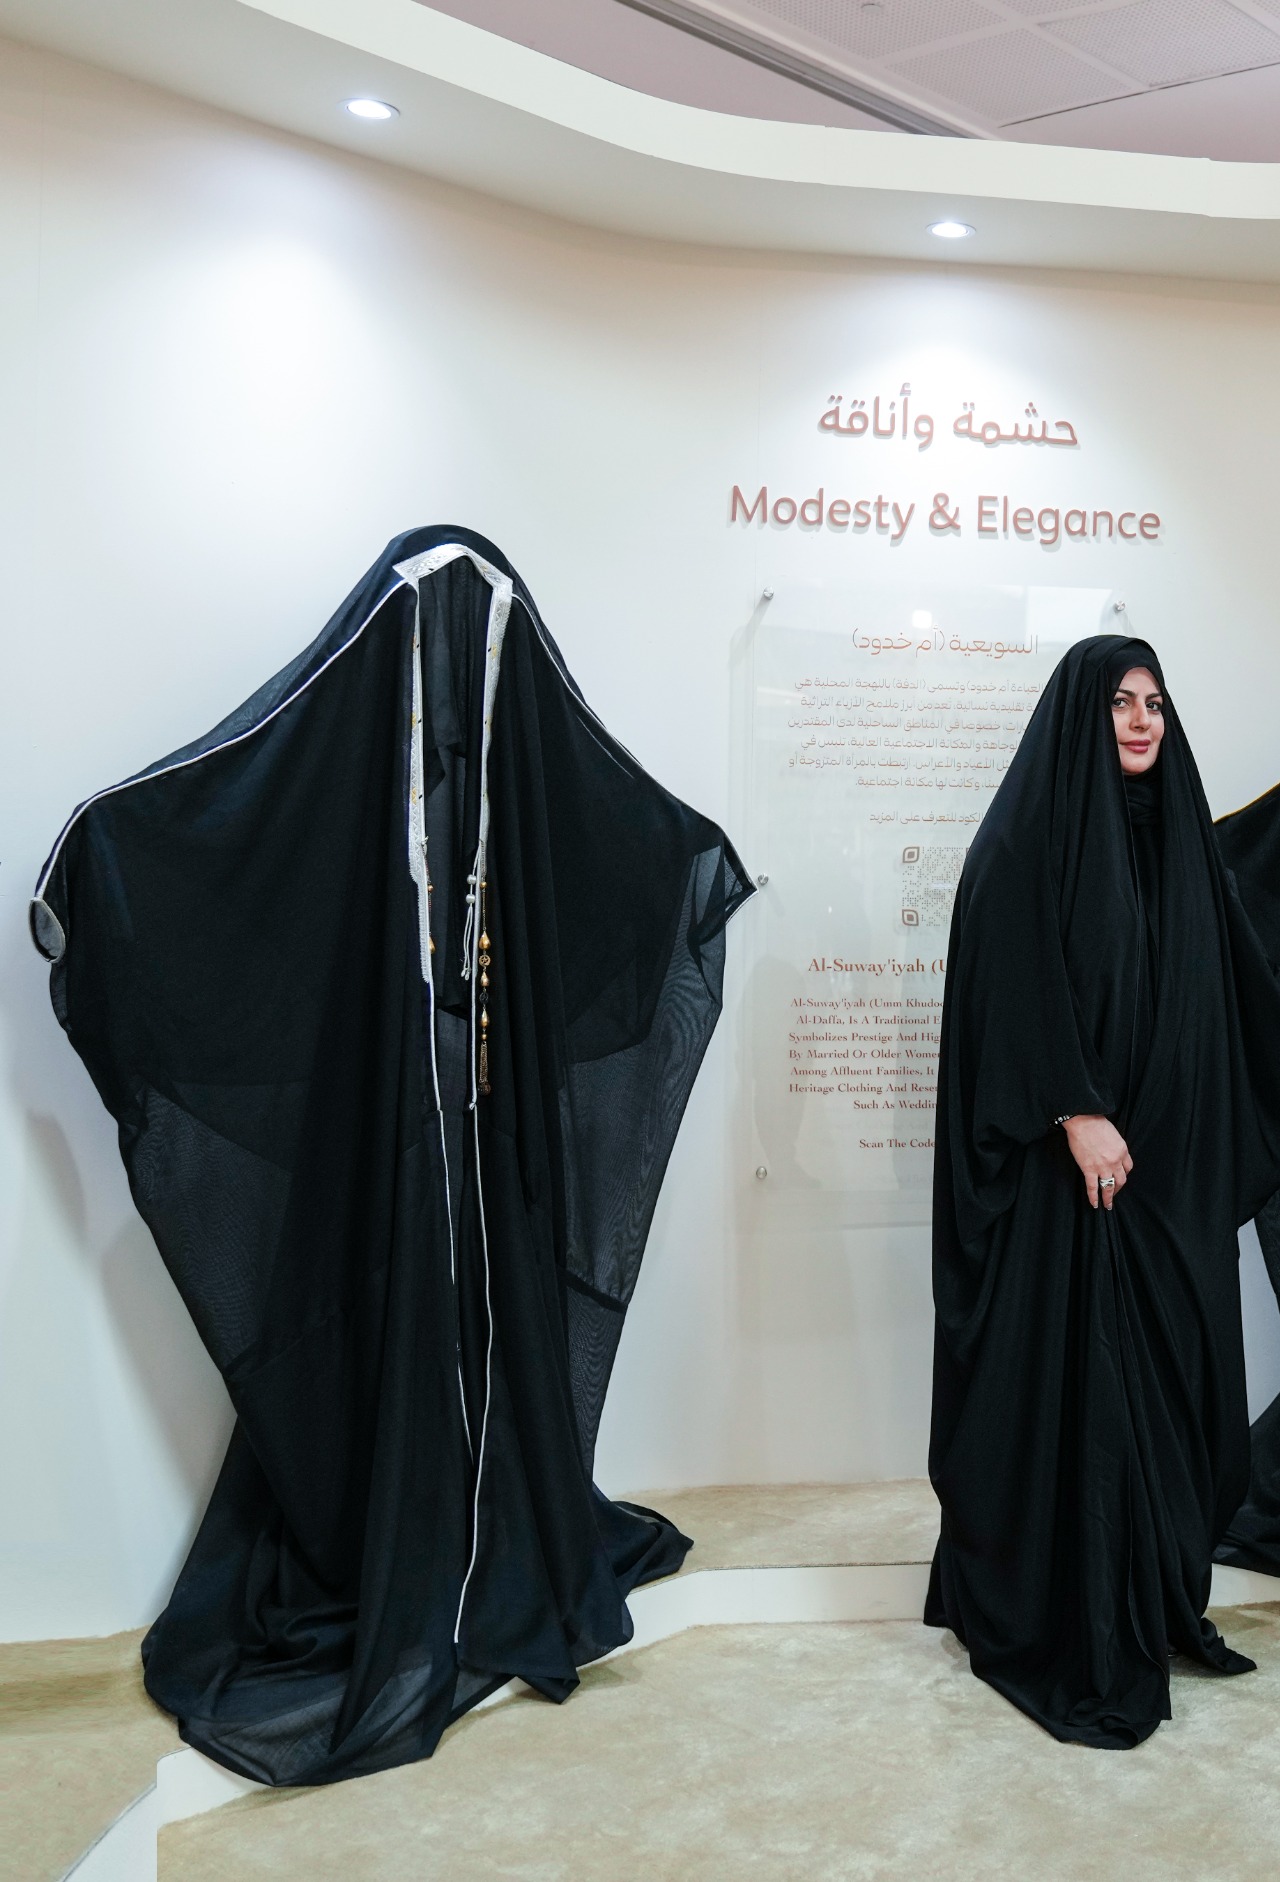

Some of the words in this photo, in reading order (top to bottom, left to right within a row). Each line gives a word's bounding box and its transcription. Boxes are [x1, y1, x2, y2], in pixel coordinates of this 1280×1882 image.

[820, 383, 935, 448] وأناقة
[953, 401, 1078, 445] حشمة
[731, 485, 915, 541] Modesty
[929, 493, 961, 531] &
[977, 496, 1161, 545] Elegance
[852, 628, 912, 656] خدود)
[949, 634, 1039, 659] السويعية
[808, 958, 925, 977] Al-Suway'iyah
[869, 998, 902, 1009] (Umm
[848, 1015, 858, 1025] Is
[861, 1015, 870, 1025] A
[872, 1014, 930, 1025] Traditional
[788, 1032, 848, 1044] Symbolizes
[851, 1032, 893, 1044] Prestige
[896, 1032, 918, 1042] And
[789, 1049, 803, 1061] By
[806, 1049, 849, 1059] Married
[852, 1050, 868, 1059] Or
[870, 1049, 902, 1059] Older
[790, 1067, 827, 1079] Among
[830, 1066, 872, 1076] Affluent
[926, 1066, 934, 1076] It
[789, 1083, 834, 1095] Heritage
[837, 1083, 883, 1095] Clothing
[886, 1083, 907, 1093] And
[853, 1100, 879, 1110] Such
[882, 1100, 895, 1110] As
[859, 1139, 884, 1149] Scan
[887, 1139, 906, 1149] The
